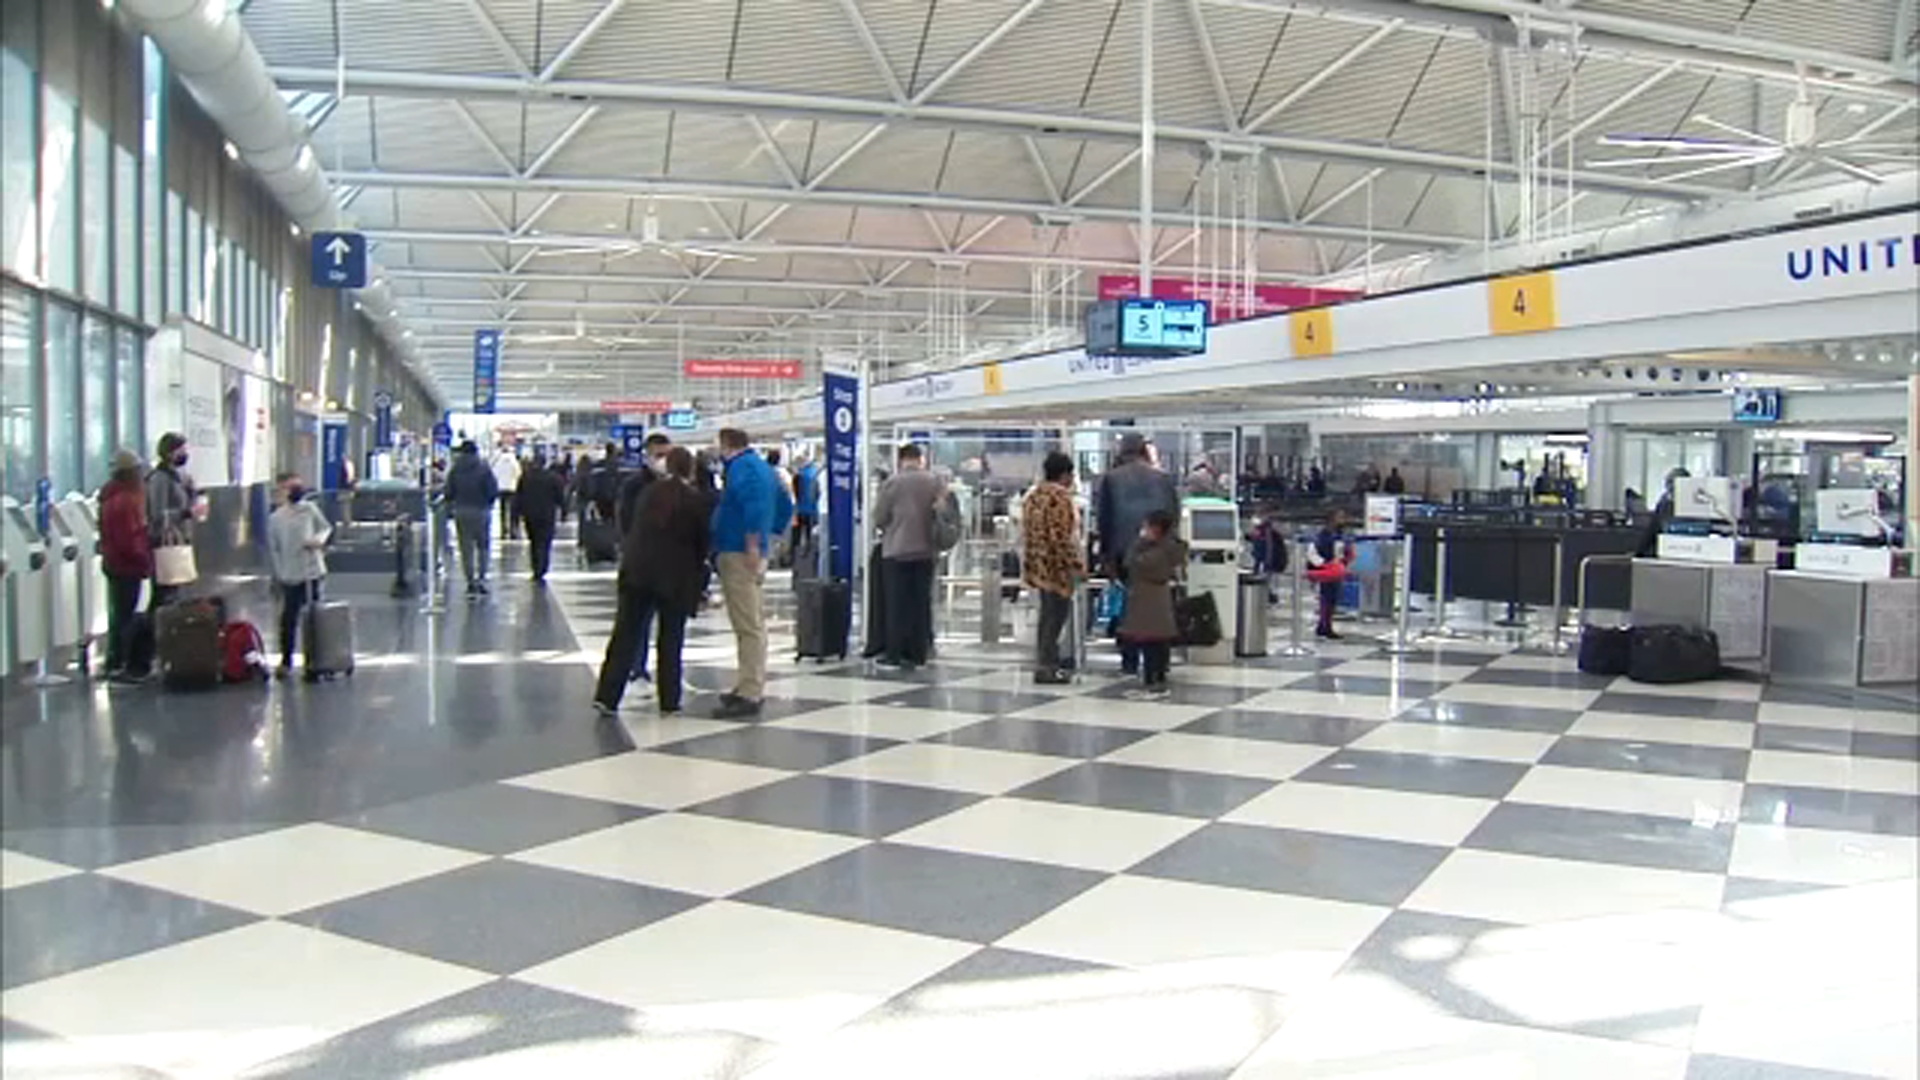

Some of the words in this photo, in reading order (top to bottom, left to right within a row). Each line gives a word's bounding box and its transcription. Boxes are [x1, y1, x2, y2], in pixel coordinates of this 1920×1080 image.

[1512, 287, 1526, 317] 4
[1138, 314, 1150, 333] 5
[1304, 320, 1315, 345] 4
